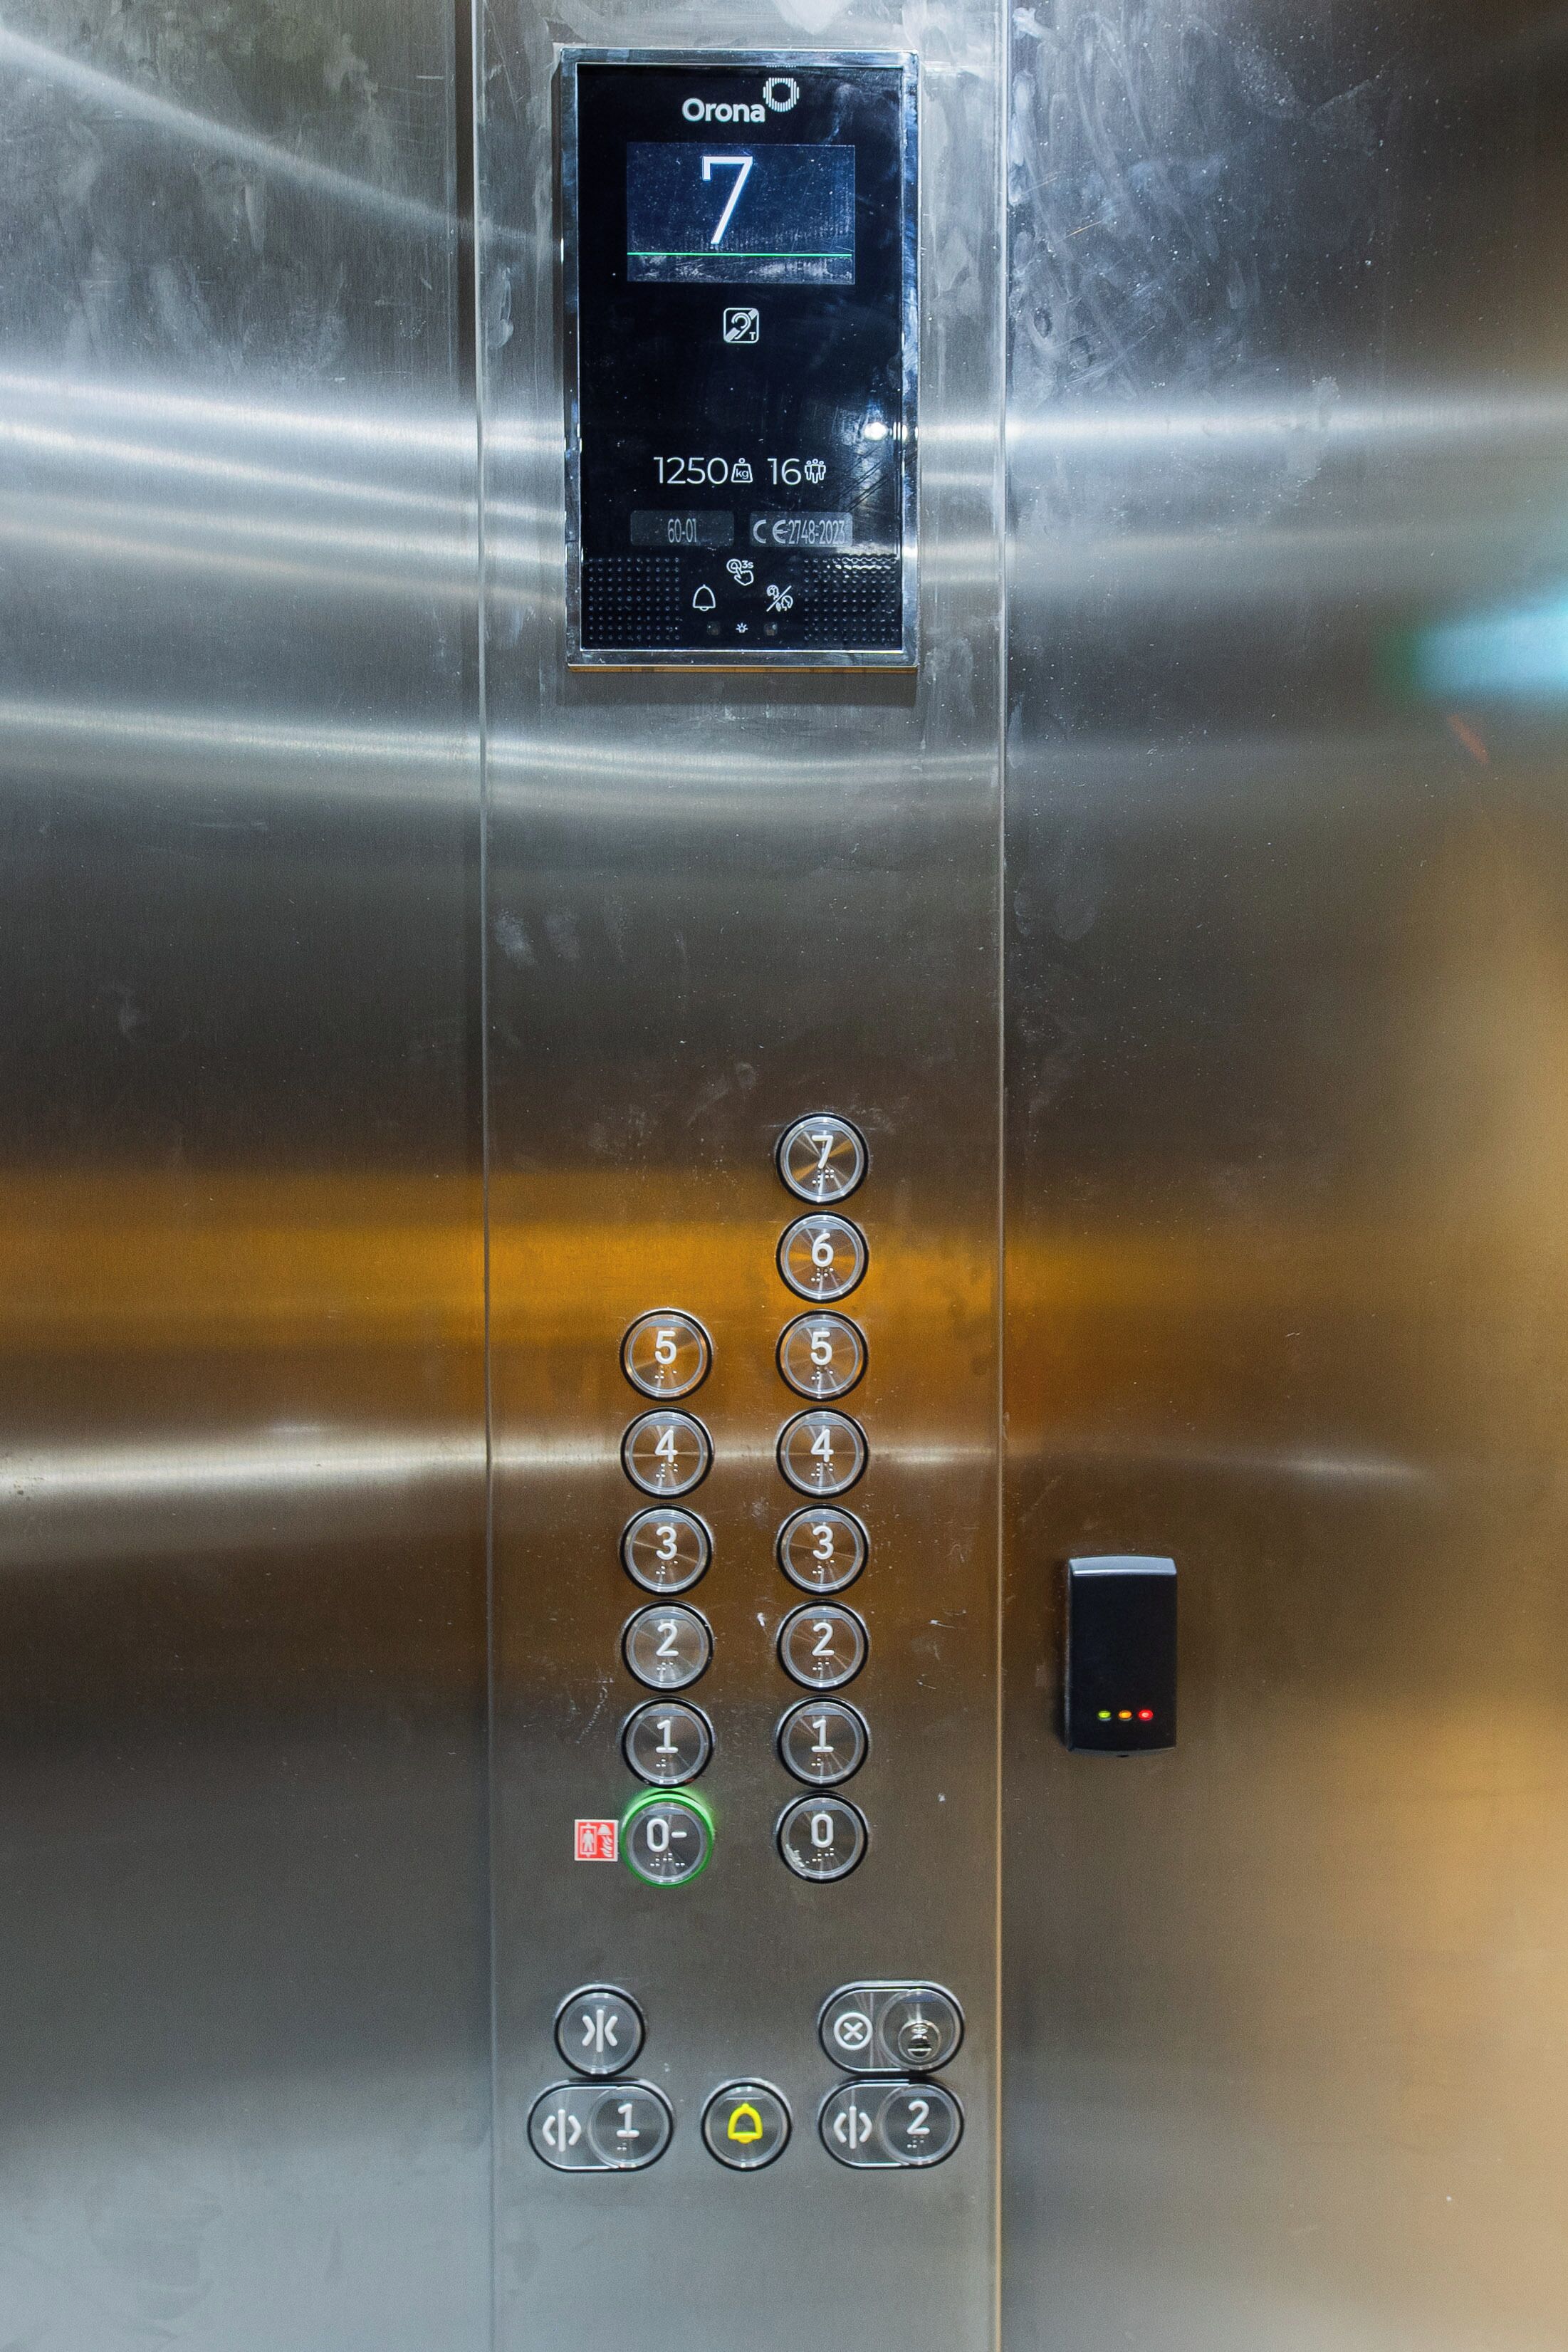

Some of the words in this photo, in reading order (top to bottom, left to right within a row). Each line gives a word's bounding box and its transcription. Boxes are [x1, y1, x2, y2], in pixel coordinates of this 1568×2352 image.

[681, 98, 765, 122] Orona
[702, 155, 753, 245] 7
[748, 331, 756, 340] T
[654, 456, 728, 485] 1250
[767, 458, 802, 486] 16
[667, 518, 697, 543] 60-01
[812, 1134, 834, 1169] 7
[811, 1233, 834, 1268] 6
[654, 1330, 677, 1365] 5
[810, 1331, 833, 1366] 5
[654, 1429, 678, 1463] 4
[810, 1429, 835, 1463] 4
[656, 1526, 677, 1560] 3
[812, 1525, 834, 1559] 3
[656, 1622, 679, 1656] 2
[812, 1622, 835, 1656] 2
[656, 1719, 679, 1754] 1
[811, 1719, 834, 1752] 1
[810, 1813, 834, 1848] 0
[617, 2103, 640, 2138] 1
[906, 2101, 930, 2135] 2
